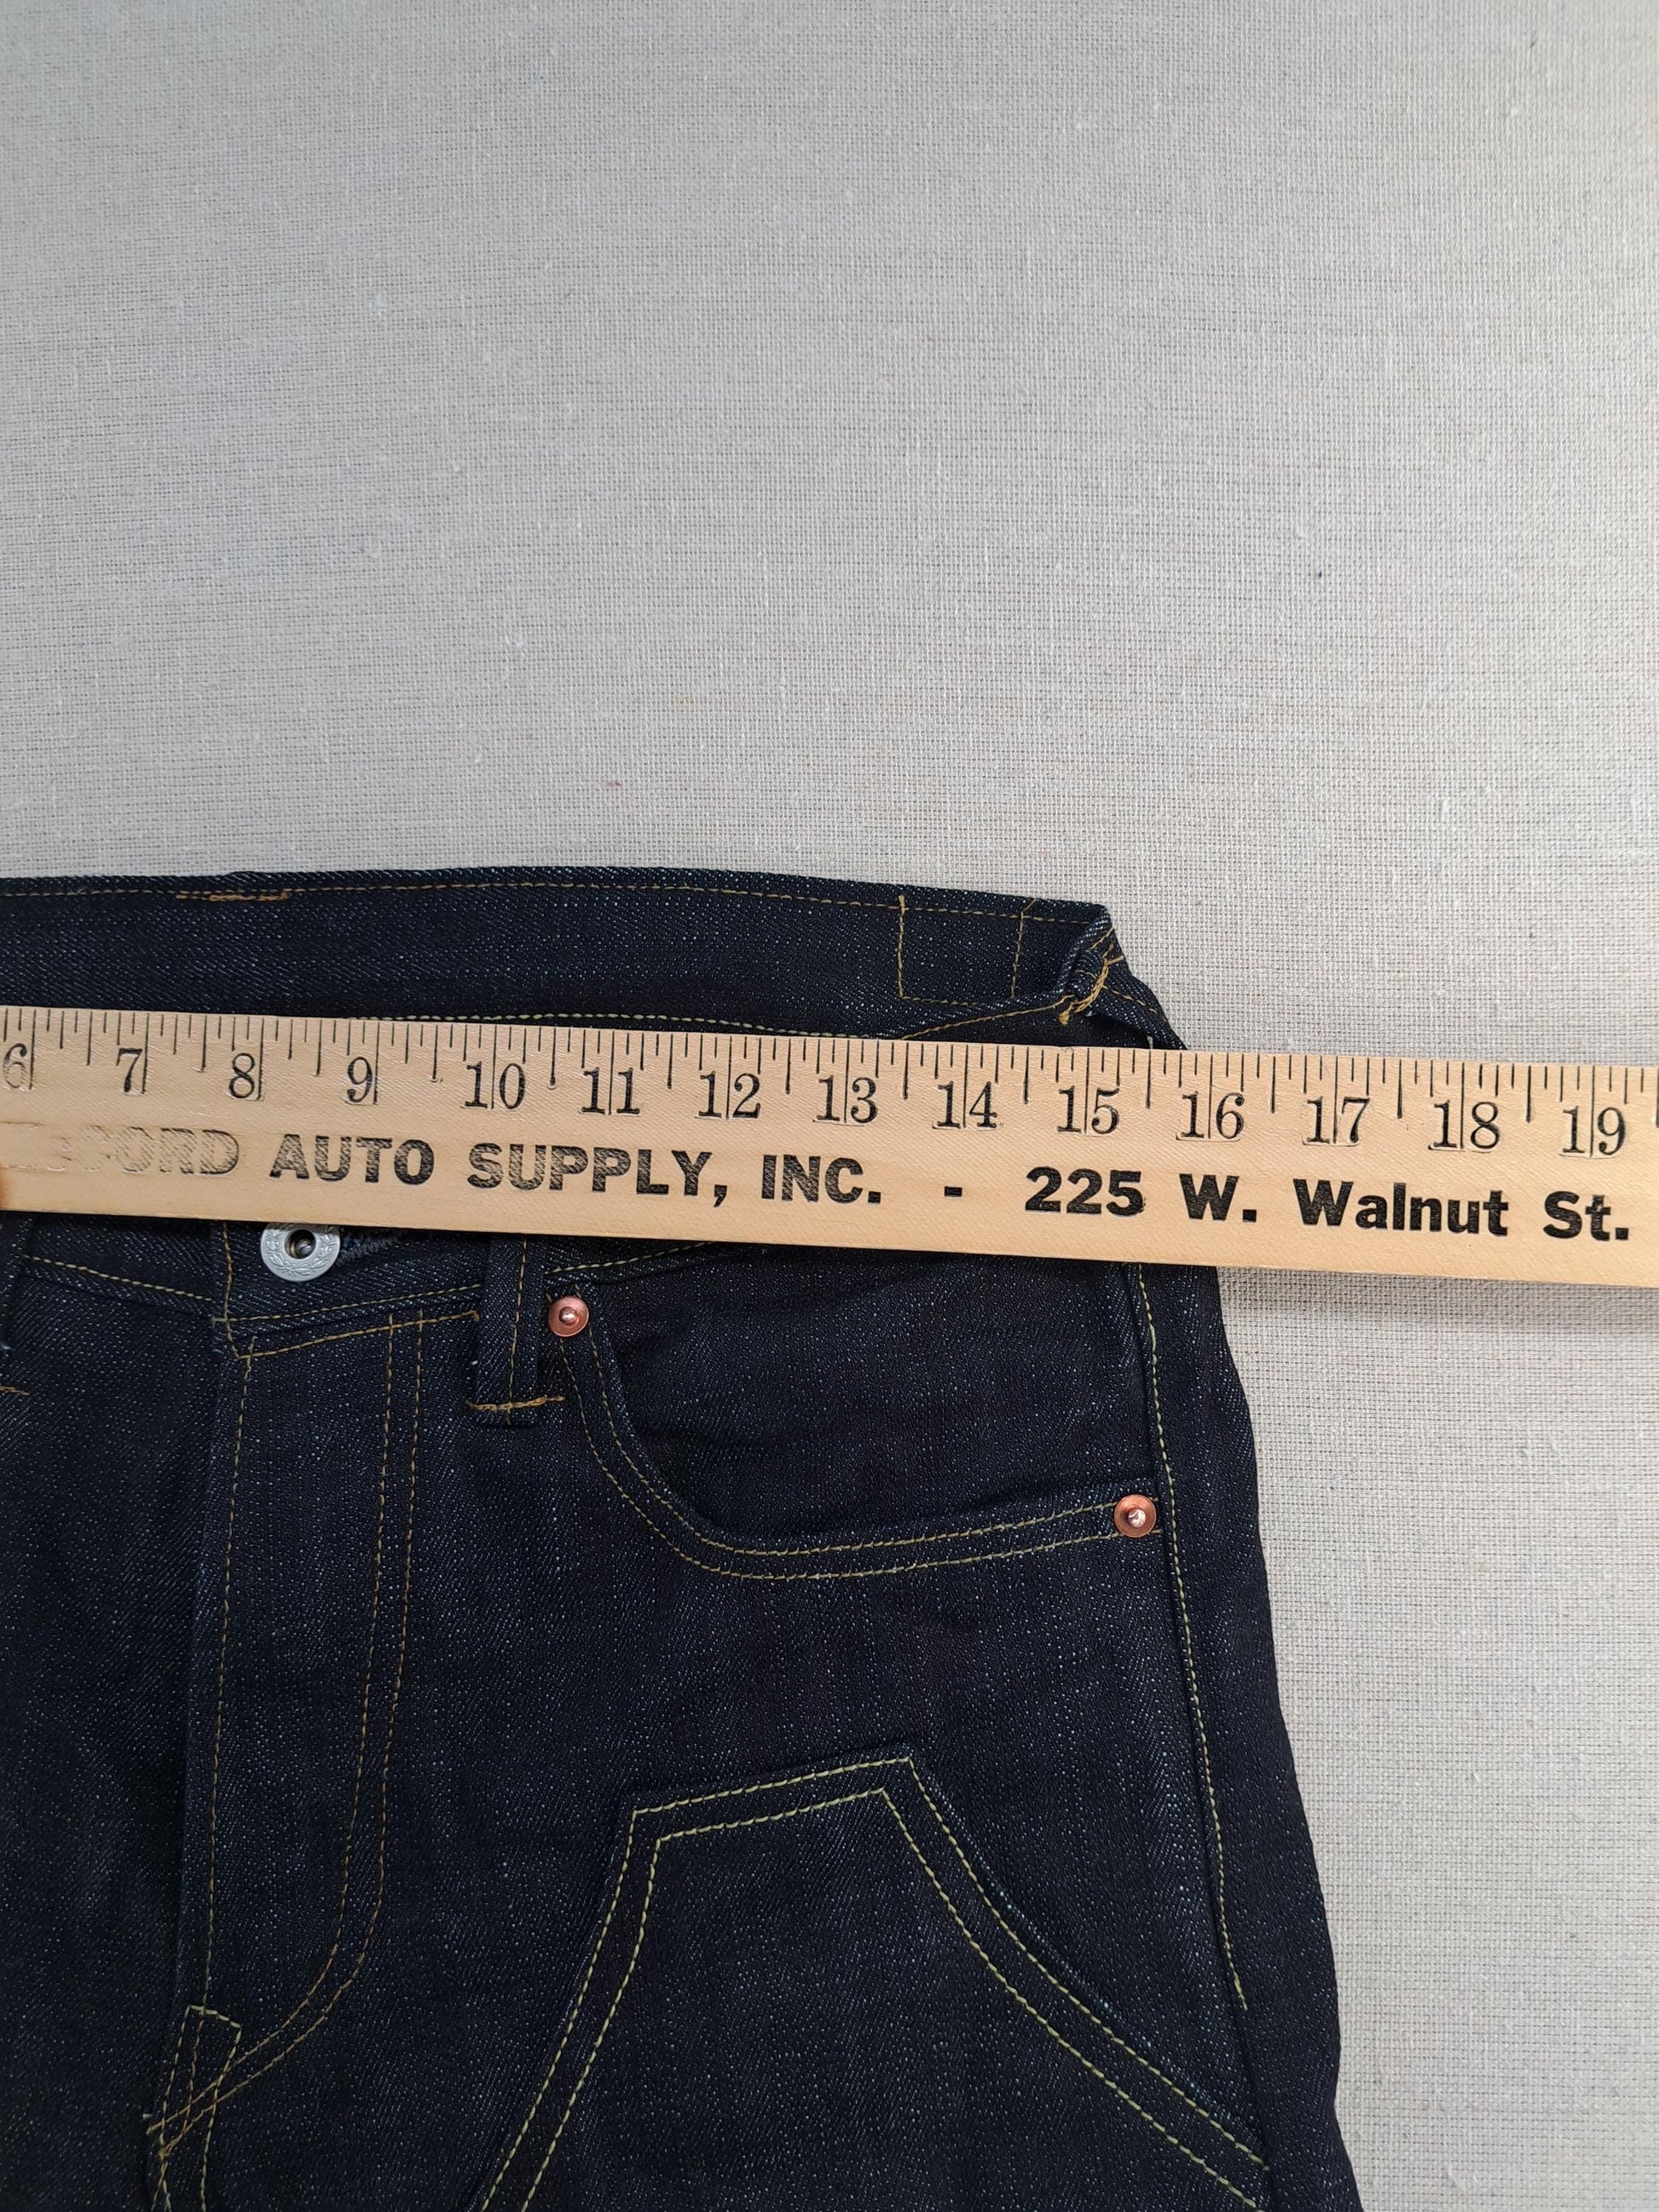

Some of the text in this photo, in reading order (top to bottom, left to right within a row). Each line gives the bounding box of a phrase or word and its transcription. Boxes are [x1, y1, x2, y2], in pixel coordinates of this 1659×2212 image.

[3, 1043, 1626, 1155] 6 7 8 9 10 11 12 13 14 15 16 17 18 19
[269, 1133, 435, 1185] AUTO
[467, 1142, 727, 1207] SUPPLY,
[761, 1154, 882, 1204] INC.
[1025, 1166, 1145, 1217] 225
[1179, 1173, 1257, 1223] W.
[1293, 1178, 1509, 1237] Walnut
[1542, 1190, 1630, 1242] St.
